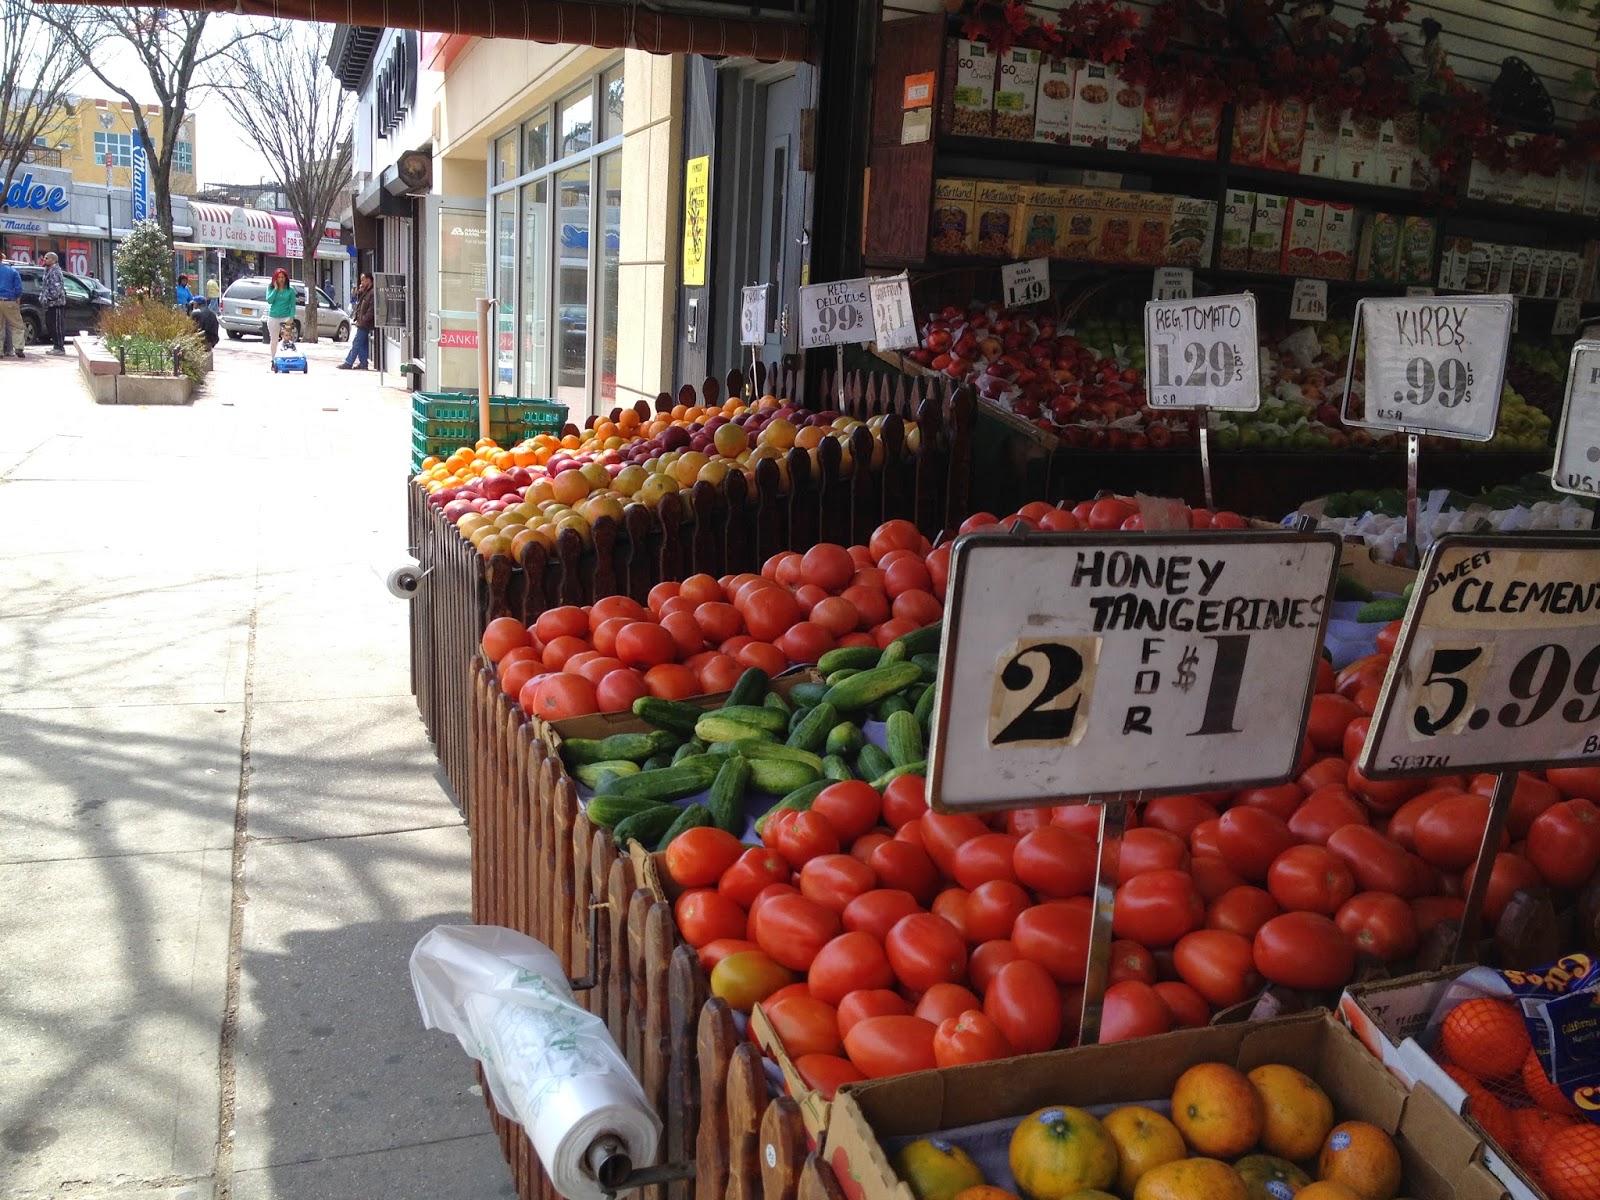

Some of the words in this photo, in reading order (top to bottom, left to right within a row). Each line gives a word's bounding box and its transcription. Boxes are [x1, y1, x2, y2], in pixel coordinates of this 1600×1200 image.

[0, 172, 69, 213] dee
[133, 145, 148, 222] Mandee
[980, 188, 1017, 202] Heartland
[1030, 192, 1064, 205] Heartland
[1178, 201, 1208, 213] Heartland
[2, 219, 42, 232] Mandee
[226, 227, 247, 241] Cards
[258, 230, 275, 243] Gifts
[287, 238, 297, 246] FOR
[70, 255, 88, 277] 10
[828, 282, 848, 296] RED
[1009, 281, 1043, 304] 1.49
[816, 293, 867, 310] DELICIOUS
[811, 304, 857, 334] .99
[1154, 341, 1235, 387] 1.29
[1393, 356, 1467, 408] .99
[1071, 550, 1226, 597] HONEY
[1088, 592, 1324, 634] TANGERINES
[991, 642, 1084, 745] 2
